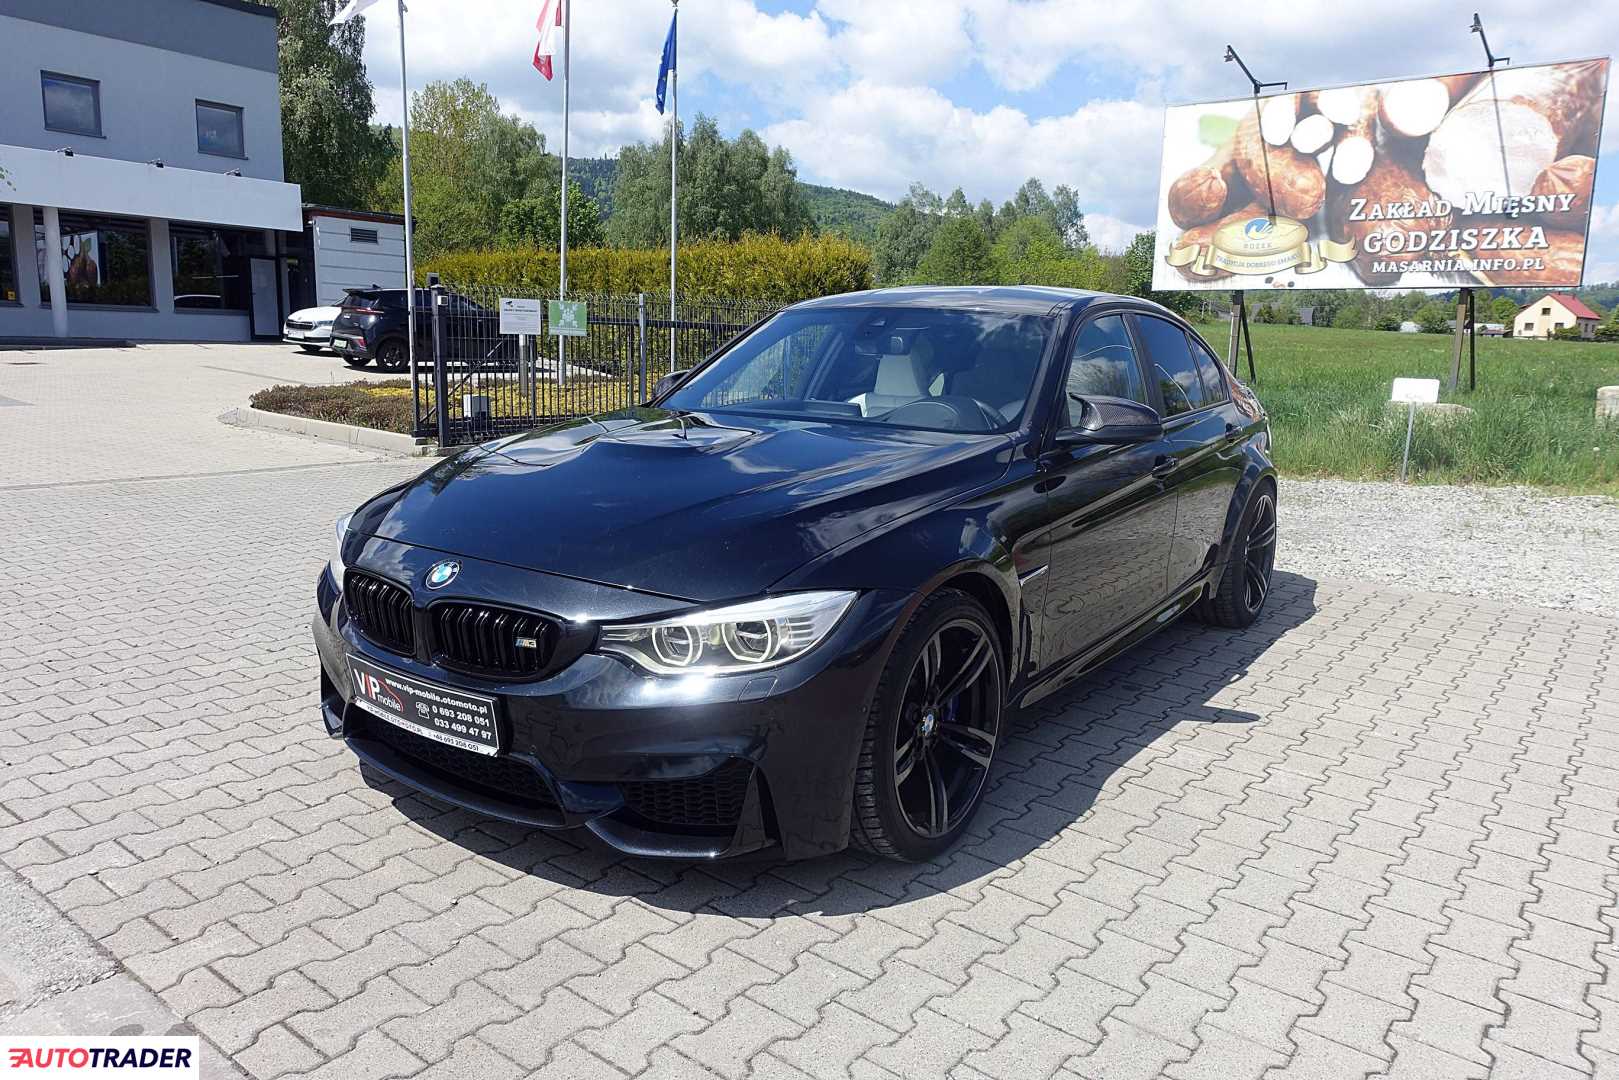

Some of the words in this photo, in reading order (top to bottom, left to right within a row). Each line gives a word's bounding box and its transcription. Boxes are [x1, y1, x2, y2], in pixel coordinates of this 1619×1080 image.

[1363, 226, 1549, 253] GODZISZKA
[1372, 257, 1545, 273] MASARNIA.INFO.PL
[354, 668, 380, 700] VIP
[377, 694, 401, 711] mobile
[384, 677, 488, 714] www.vip-mobile.otomoto.pl
[432, 705, 438, 713] 0
[439, 707, 455, 718] 693
[456, 711, 473, 722] 208
[474, 716, 490, 727] 051
[434, 718, 449, 729] 033
[451, 722, 467, 734] 499
[468, 727, 479, 736] 47
[481, 730, 492, 740] 97
